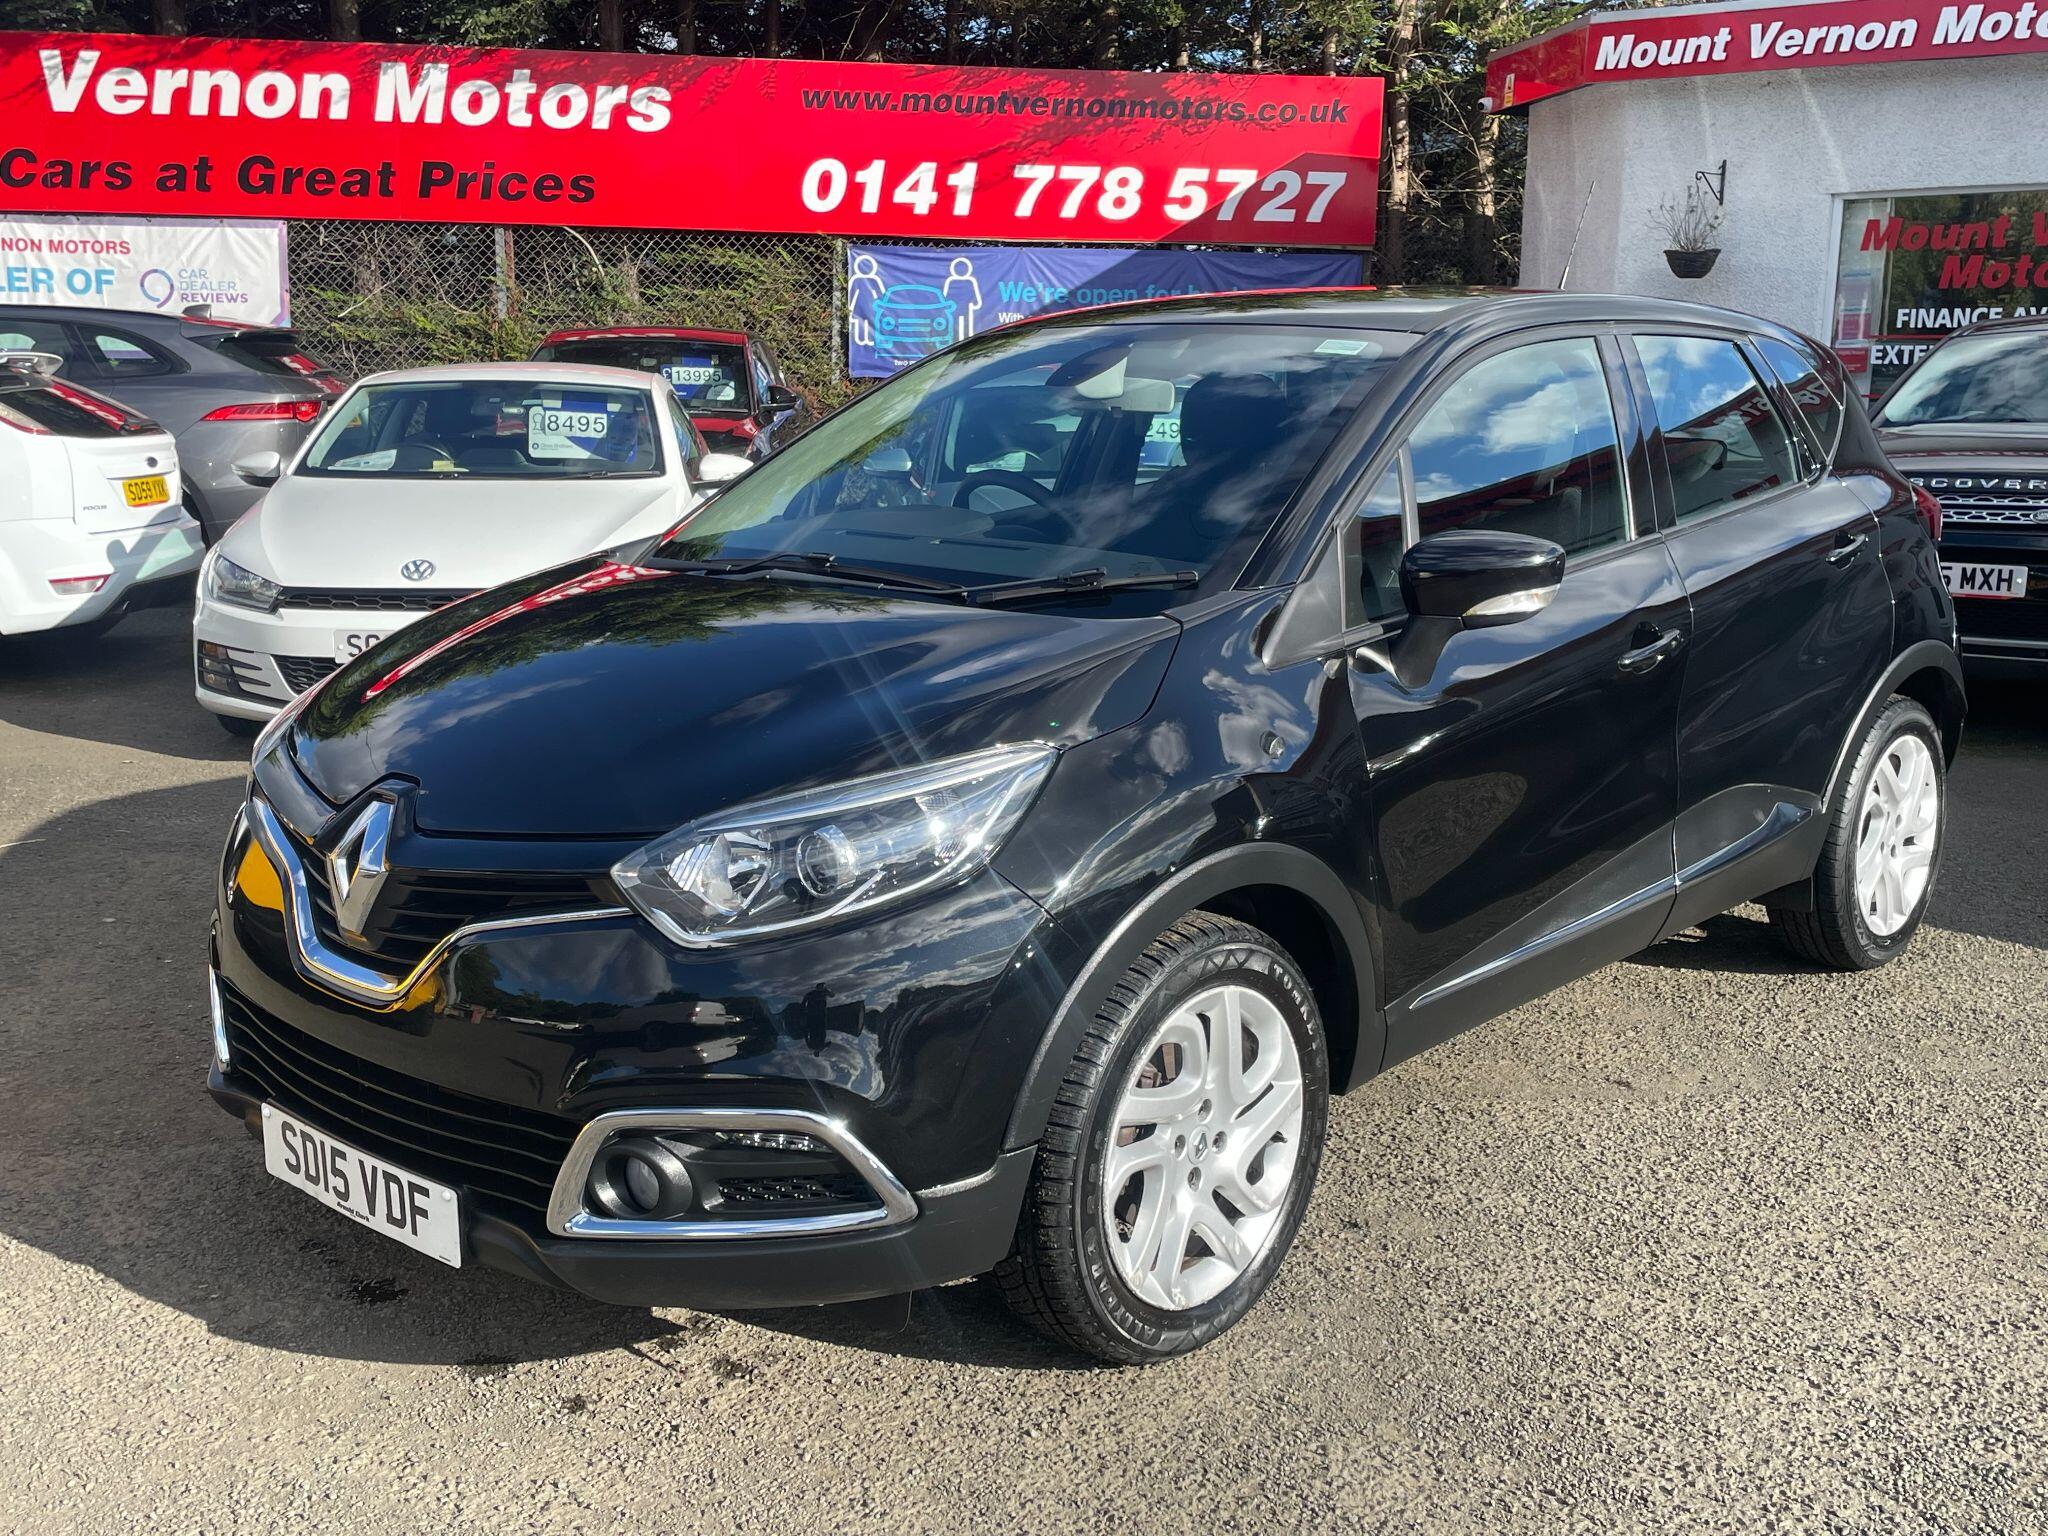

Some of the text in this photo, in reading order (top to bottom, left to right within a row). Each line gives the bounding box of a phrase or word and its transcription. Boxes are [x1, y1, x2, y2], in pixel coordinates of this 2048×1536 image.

[1594, 27, 1732, 71] Mount
[1748, 17, 1918, 60] Vernon
[38, 48, 673, 133] Vernon Motors
[802, 88, 1350, 125] www.mountvernonmotors.co.uk
[0, 147, 597, 204] Cars at Great Prices
[800, 158, 1349, 223] 0141 778 5727
[1, 237, 132, 255] NON MOTORS
[1860, 214, 2011, 252] Mount
[0, 266, 115, 295] ER OF
[178, 268, 208, 280] CAR
[179, 280, 237, 292] DEALER
[180, 292, 249, 304] REVIEWS
[998, 280, 1069, 304] We're
[1077, 286, 1139, 305] open
[1896, 306, 2004, 329] FINANCE
[1959, 566, 2014, 593] MXH
[281, 1120, 430, 1238] SD15 VDF
